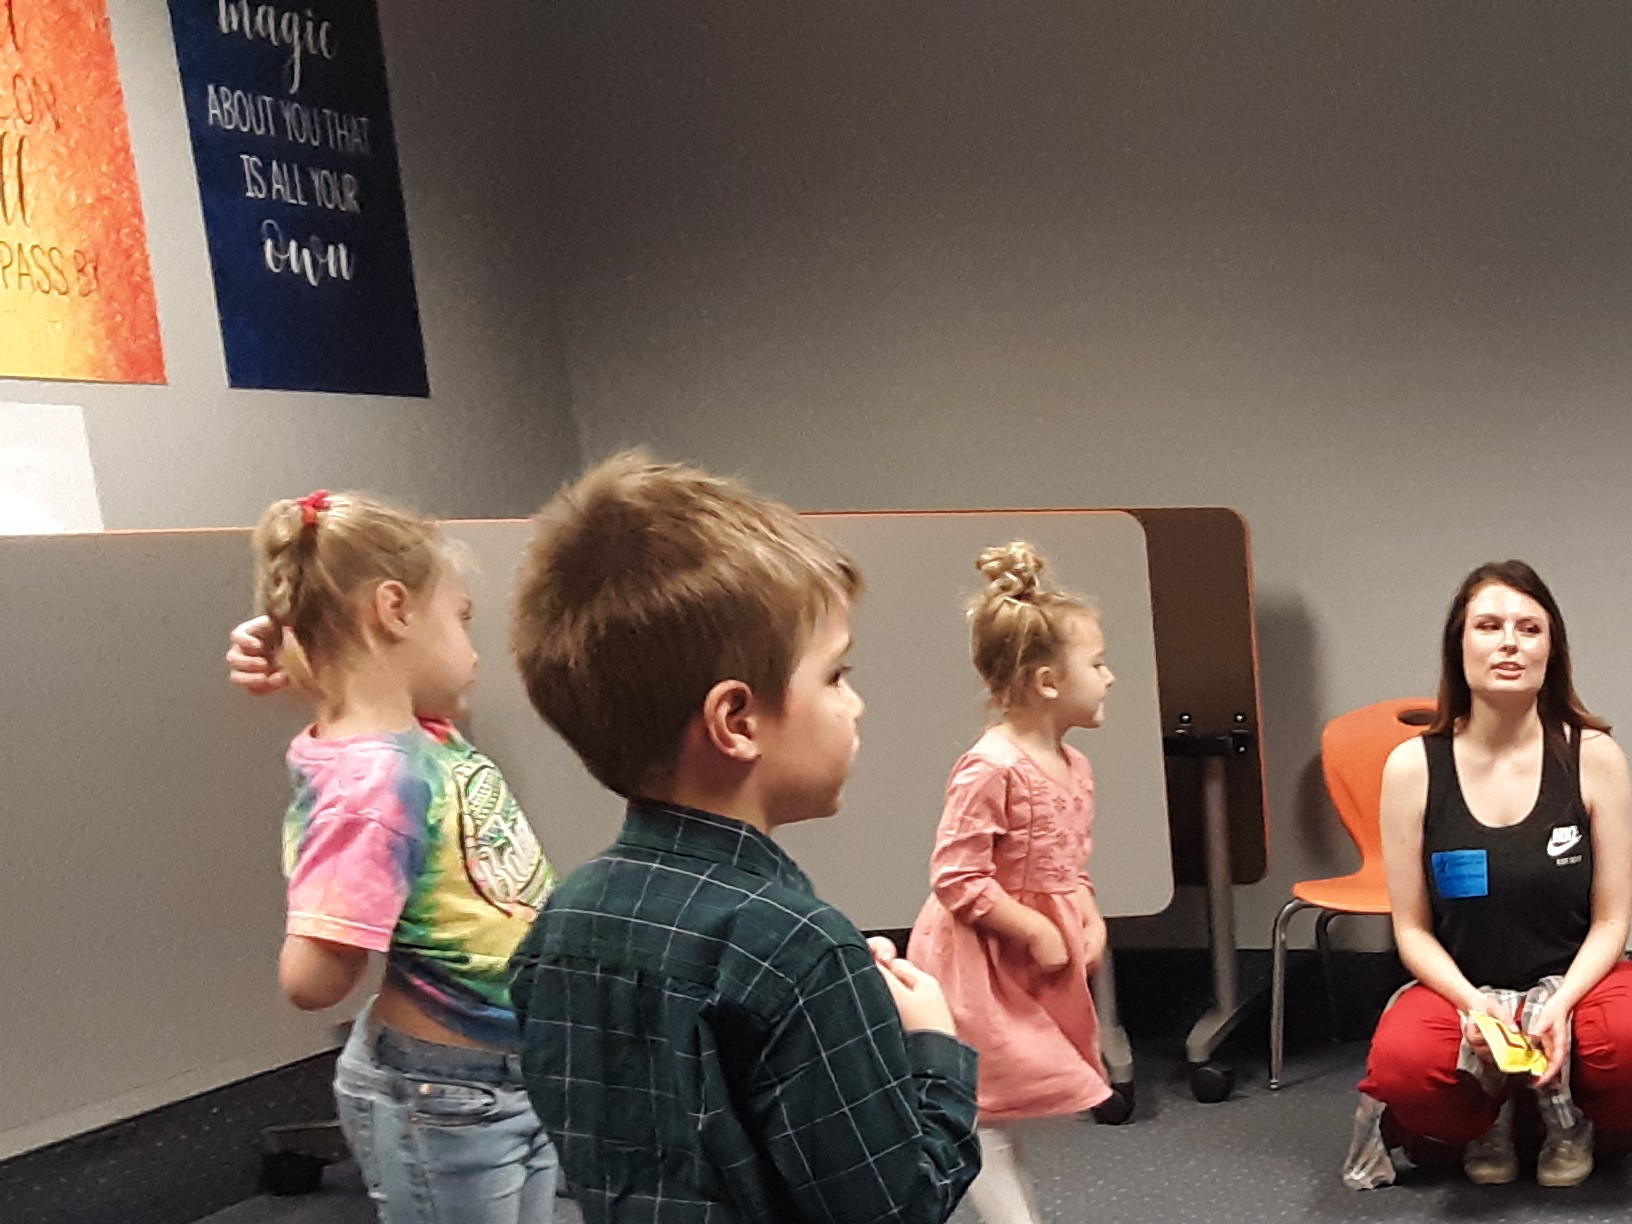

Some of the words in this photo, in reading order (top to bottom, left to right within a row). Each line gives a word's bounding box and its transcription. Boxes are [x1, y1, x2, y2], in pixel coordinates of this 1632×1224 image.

[207, 84, 275, 136] ABOUT
[280, 100, 320, 147] YOU
[322, 108, 370, 154] THAT
[240, 154, 267, 198] IS
[272, 160, 308, 206] ALL
[309, 167, 361, 213] YOUR
[0, 240, 69, 295] PASS
